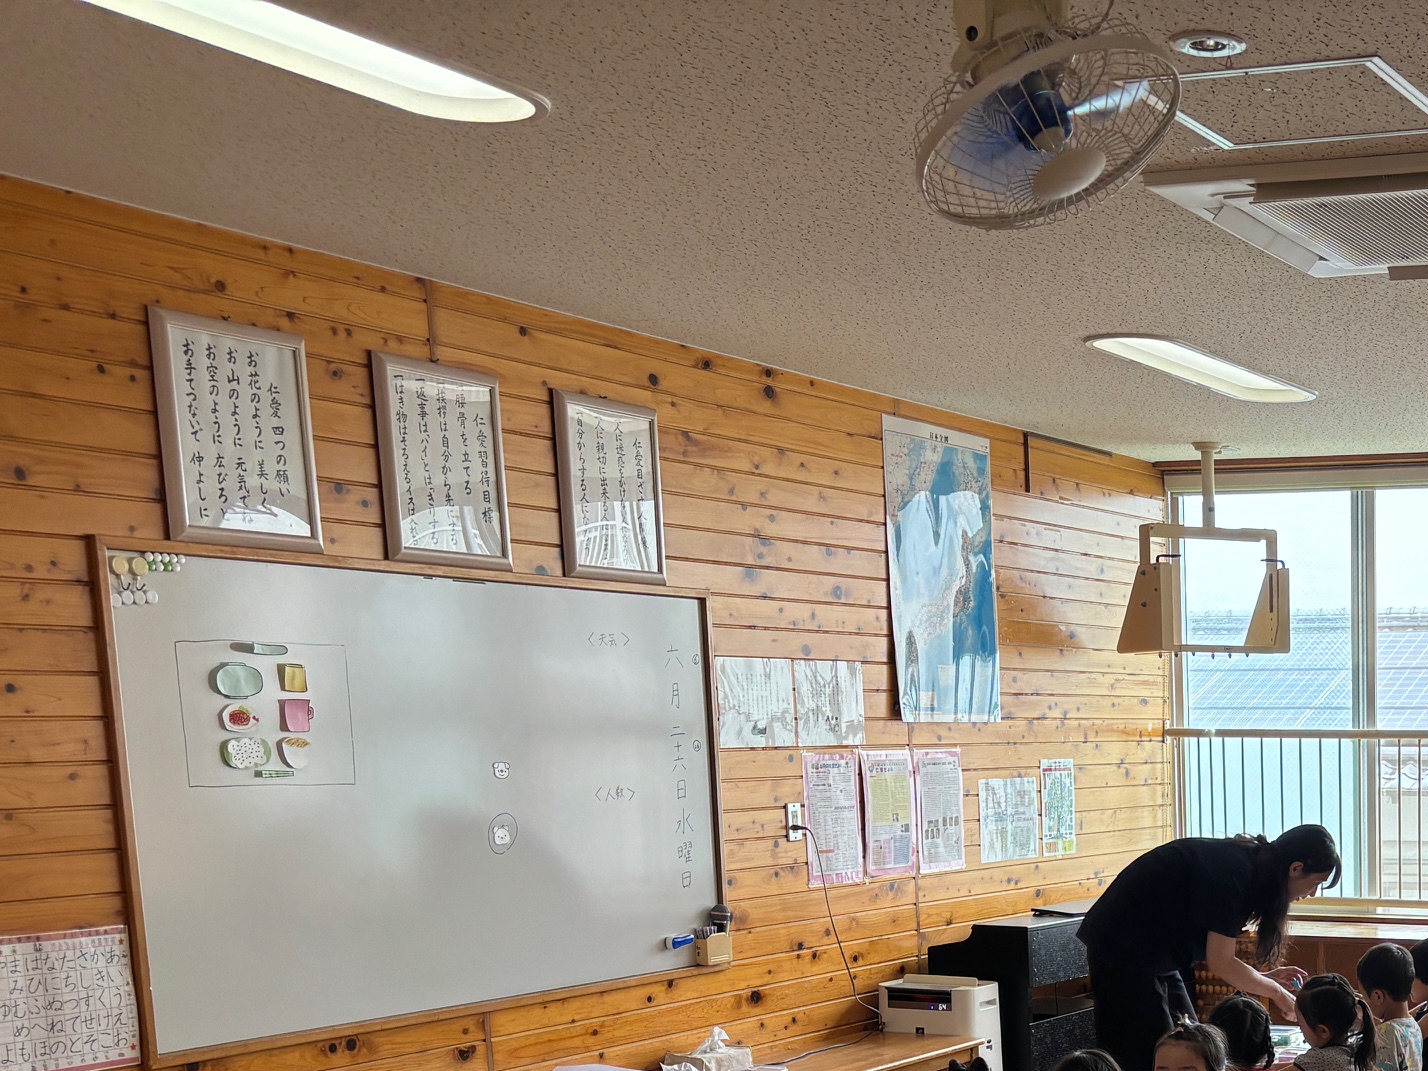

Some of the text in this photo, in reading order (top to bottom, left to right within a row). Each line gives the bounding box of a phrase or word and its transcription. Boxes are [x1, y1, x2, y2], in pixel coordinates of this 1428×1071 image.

[182, 338, 210, 519] お手てつないで 仲よしに
[206, 343, 223, 445] お空のように
[226, 346, 244, 449] お山のように
[246, 350, 270, 511] お花のように 美しく
[472, 413, 494, 524] 仁愛習得目標
